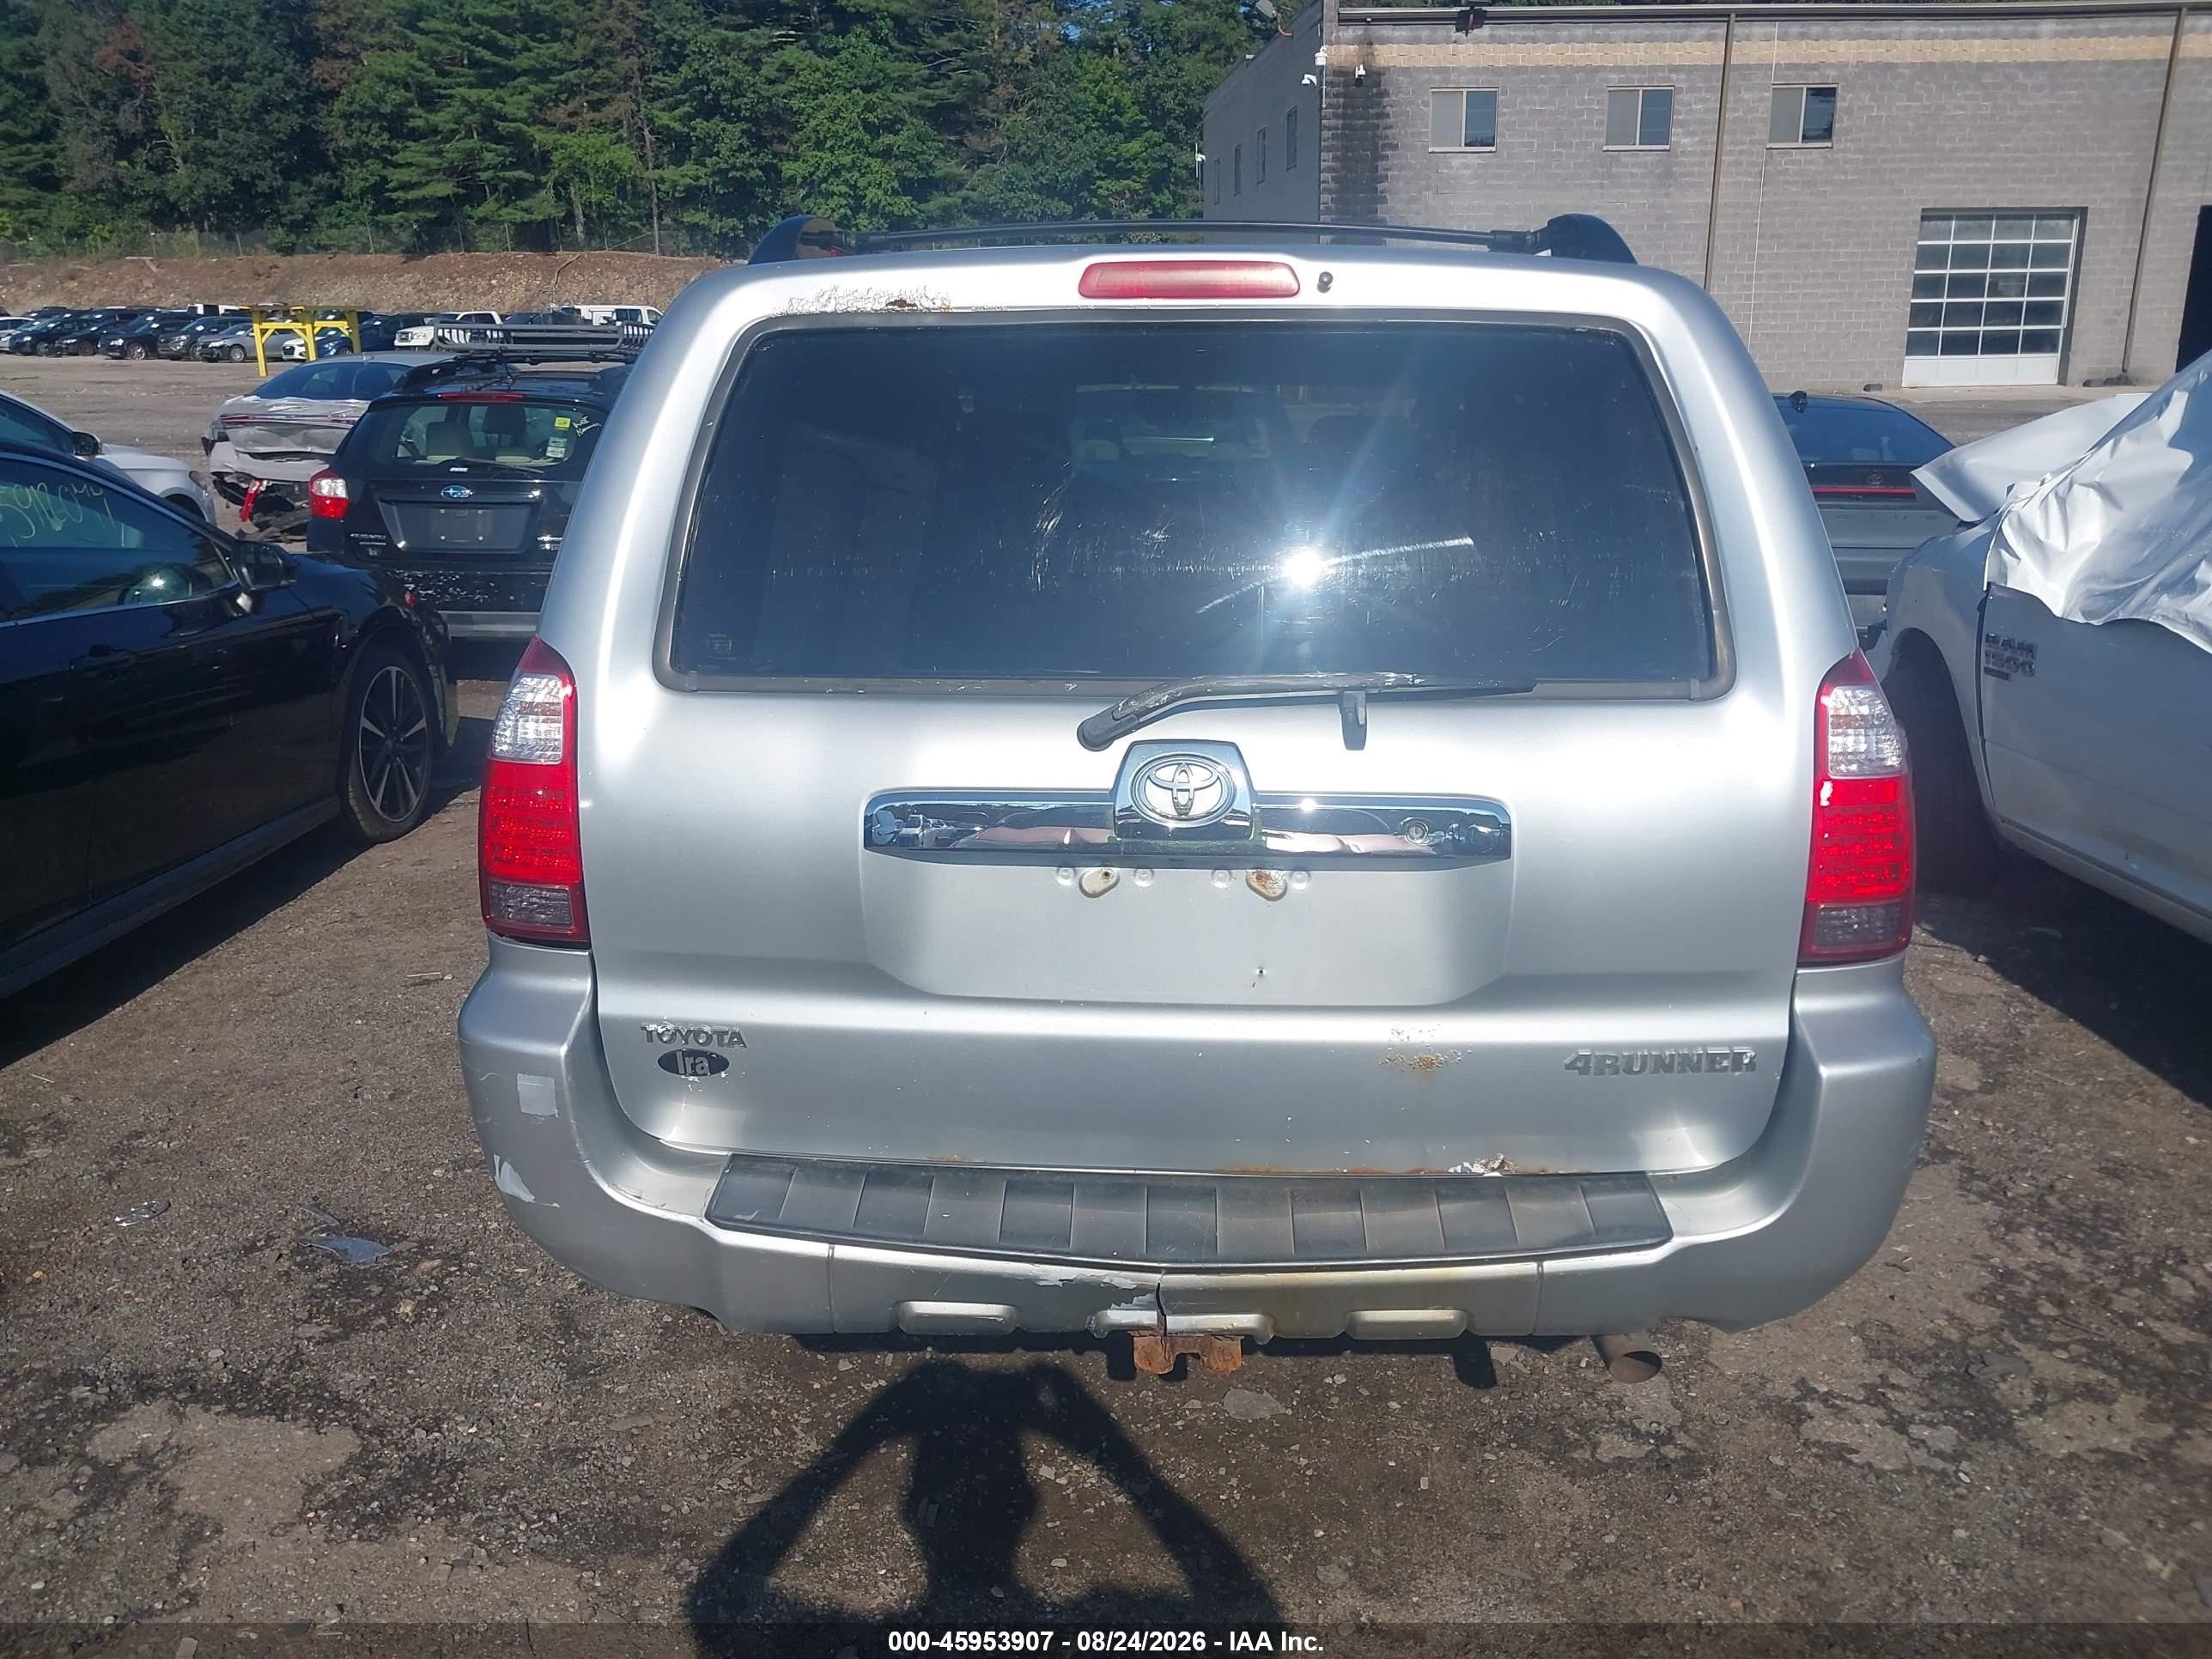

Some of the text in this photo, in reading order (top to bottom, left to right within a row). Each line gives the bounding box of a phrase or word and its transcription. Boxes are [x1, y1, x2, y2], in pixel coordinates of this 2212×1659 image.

[1984, 633, 2038, 659] RAM
[1984, 649, 2036, 678] 1500
[641, 1021, 748, 1048] TOYOTA
[676, 1050, 710, 1075] Ira
[1564, 1046, 1757, 1076] 4RUNNER
